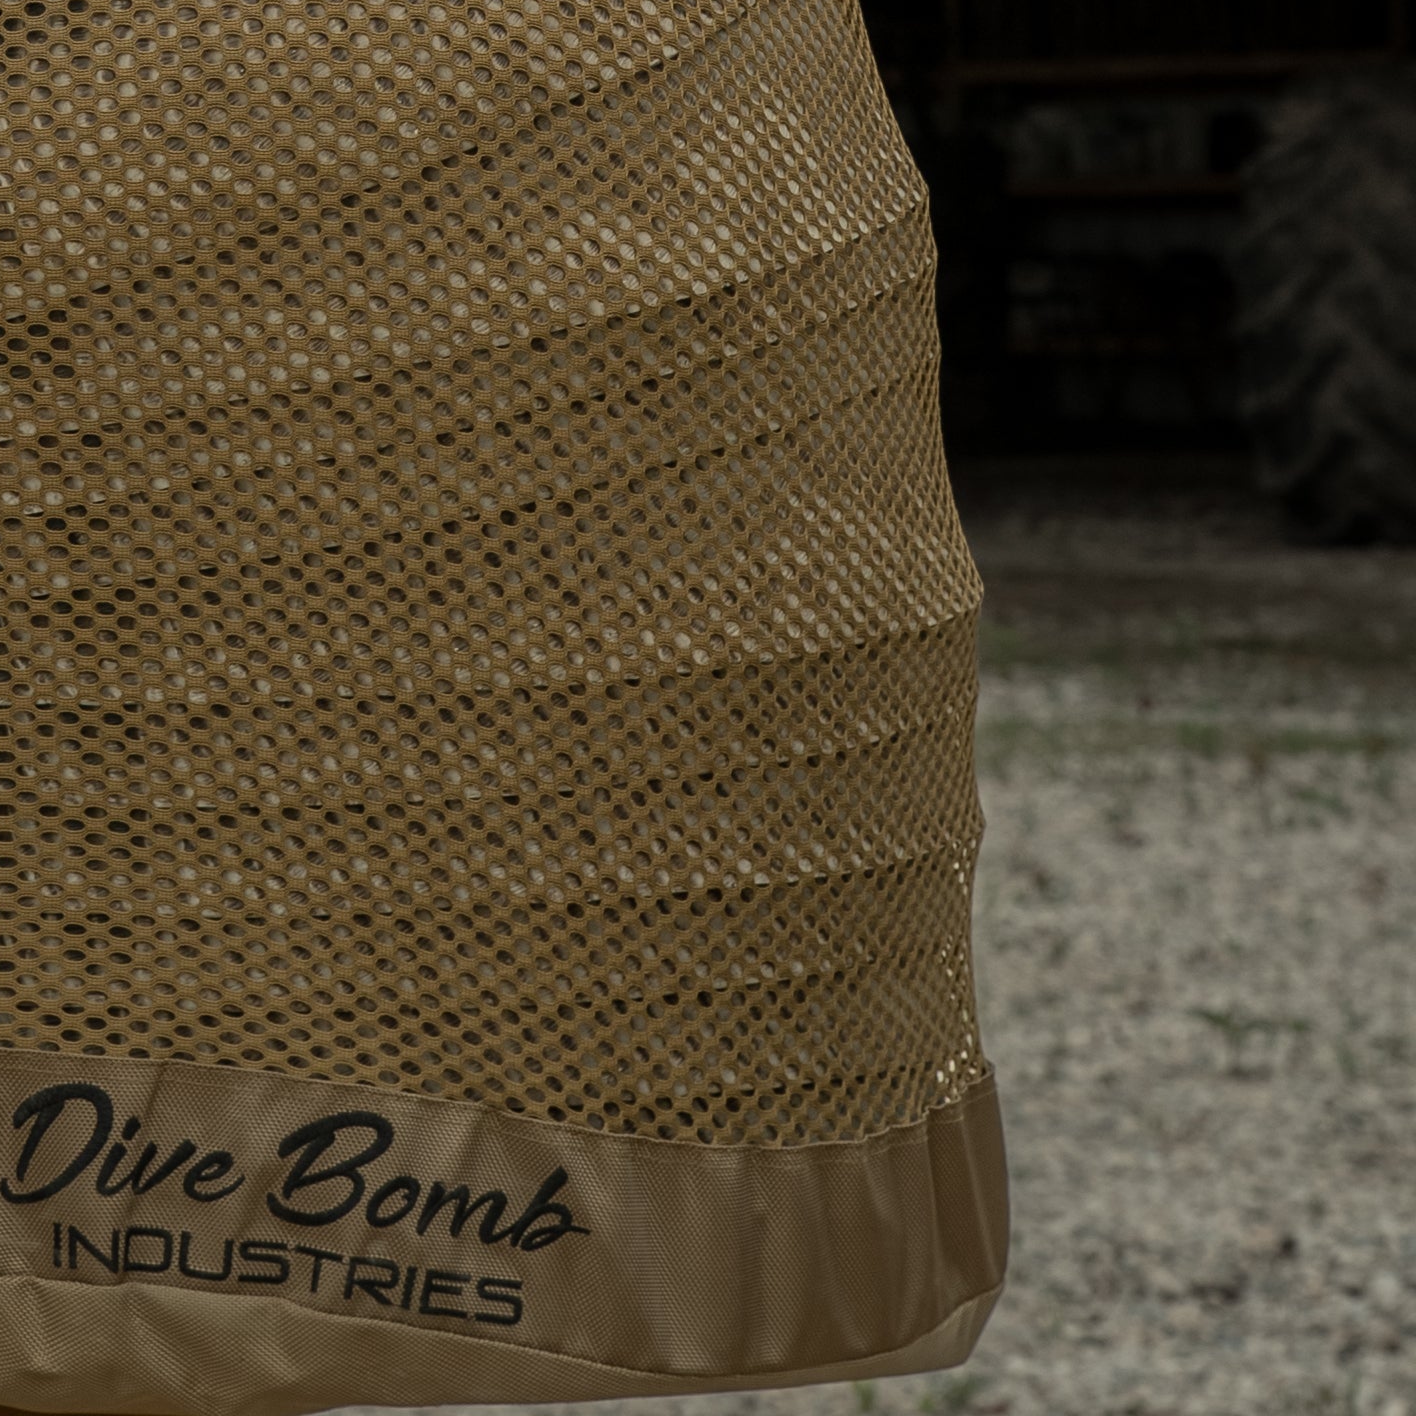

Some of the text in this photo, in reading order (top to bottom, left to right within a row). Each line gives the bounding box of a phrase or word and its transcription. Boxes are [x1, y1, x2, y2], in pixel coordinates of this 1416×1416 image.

[0, 1082, 590, 1252] Dive Bomb
[51, 1222, 524, 1327] INDUSTRIES
